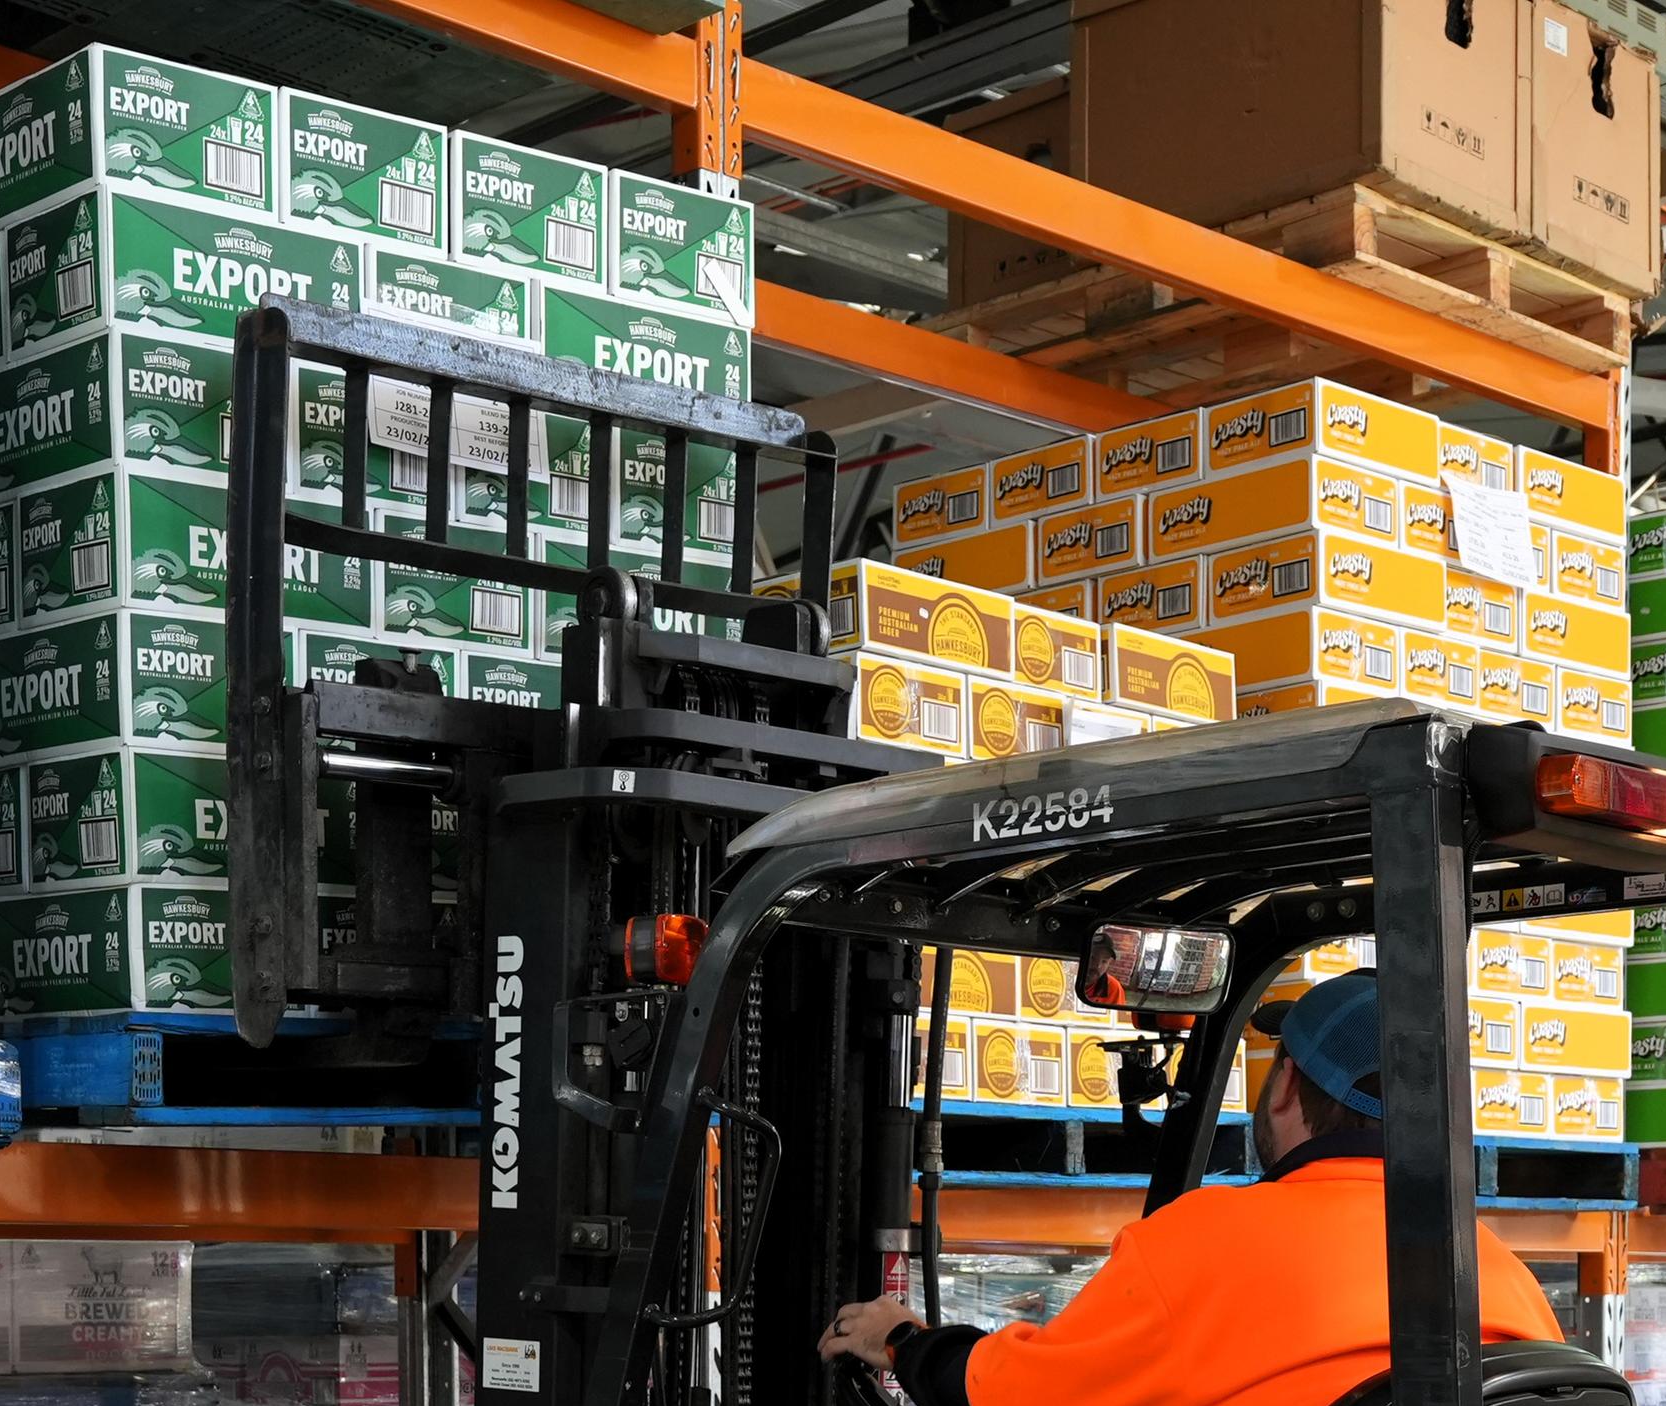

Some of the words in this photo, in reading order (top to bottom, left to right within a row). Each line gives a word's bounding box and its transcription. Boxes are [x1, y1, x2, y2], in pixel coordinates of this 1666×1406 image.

[125, 70, 174, 94] HAWKESBURY
[68, 98, 82, 122] 24
[109, 87, 190, 125] EXPORT
[210, 125, 227, 141] 24x
[245, 121, 264, 143] 24
[293, 129, 368, 167] EXPORT
[386, 165, 401, 179] 24x
[418, 161, 435, 181] 24
[479, 156, 522, 176] HAWKESBURY
[466, 171, 534, 206] EXPORT
[579, 200, 597, 220] 24
[623, 208, 687, 241] EXPORT
[214, 233, 274, 261] HAWKESBURY
[381, 284, 453, 318] EXPORT
[143, 354, 191, 372] HAWKESBURY
[594, 335, 709, 391] EXPORT
[128, 368, 207, 402] EXPORT
[1211, 407, 1266, 449] Coasty
[1327, 402, 1368, 436] Coasty
[474, 435, 487, 443] BEST
[1101, 434, 1154, 473] Coasty
[1528, 468, 1563, 497] Coasty
[899, 489, 944, 524] Coasty
[1045, 519, 1092, 557] Coasty
[1215, 557, 1270, 597] Coasty
[878, 606, 910, 621] PREMIUM
[879, 615, 919, 633] AUSTRALIAN
[879, 625, 900, 639] LAGER
[137, 648, 214, 677] EXPORT
[935, 639, 981, 662] HAWKESBURY
[1, 663, 83, 718] EXPORT
[971, 784, 1115, 843] K22584
[105, 931, 119, 949] 24
[149, 922, 226, 945] EXPORT
[492, 935, 524, 1210] KOMATSU
